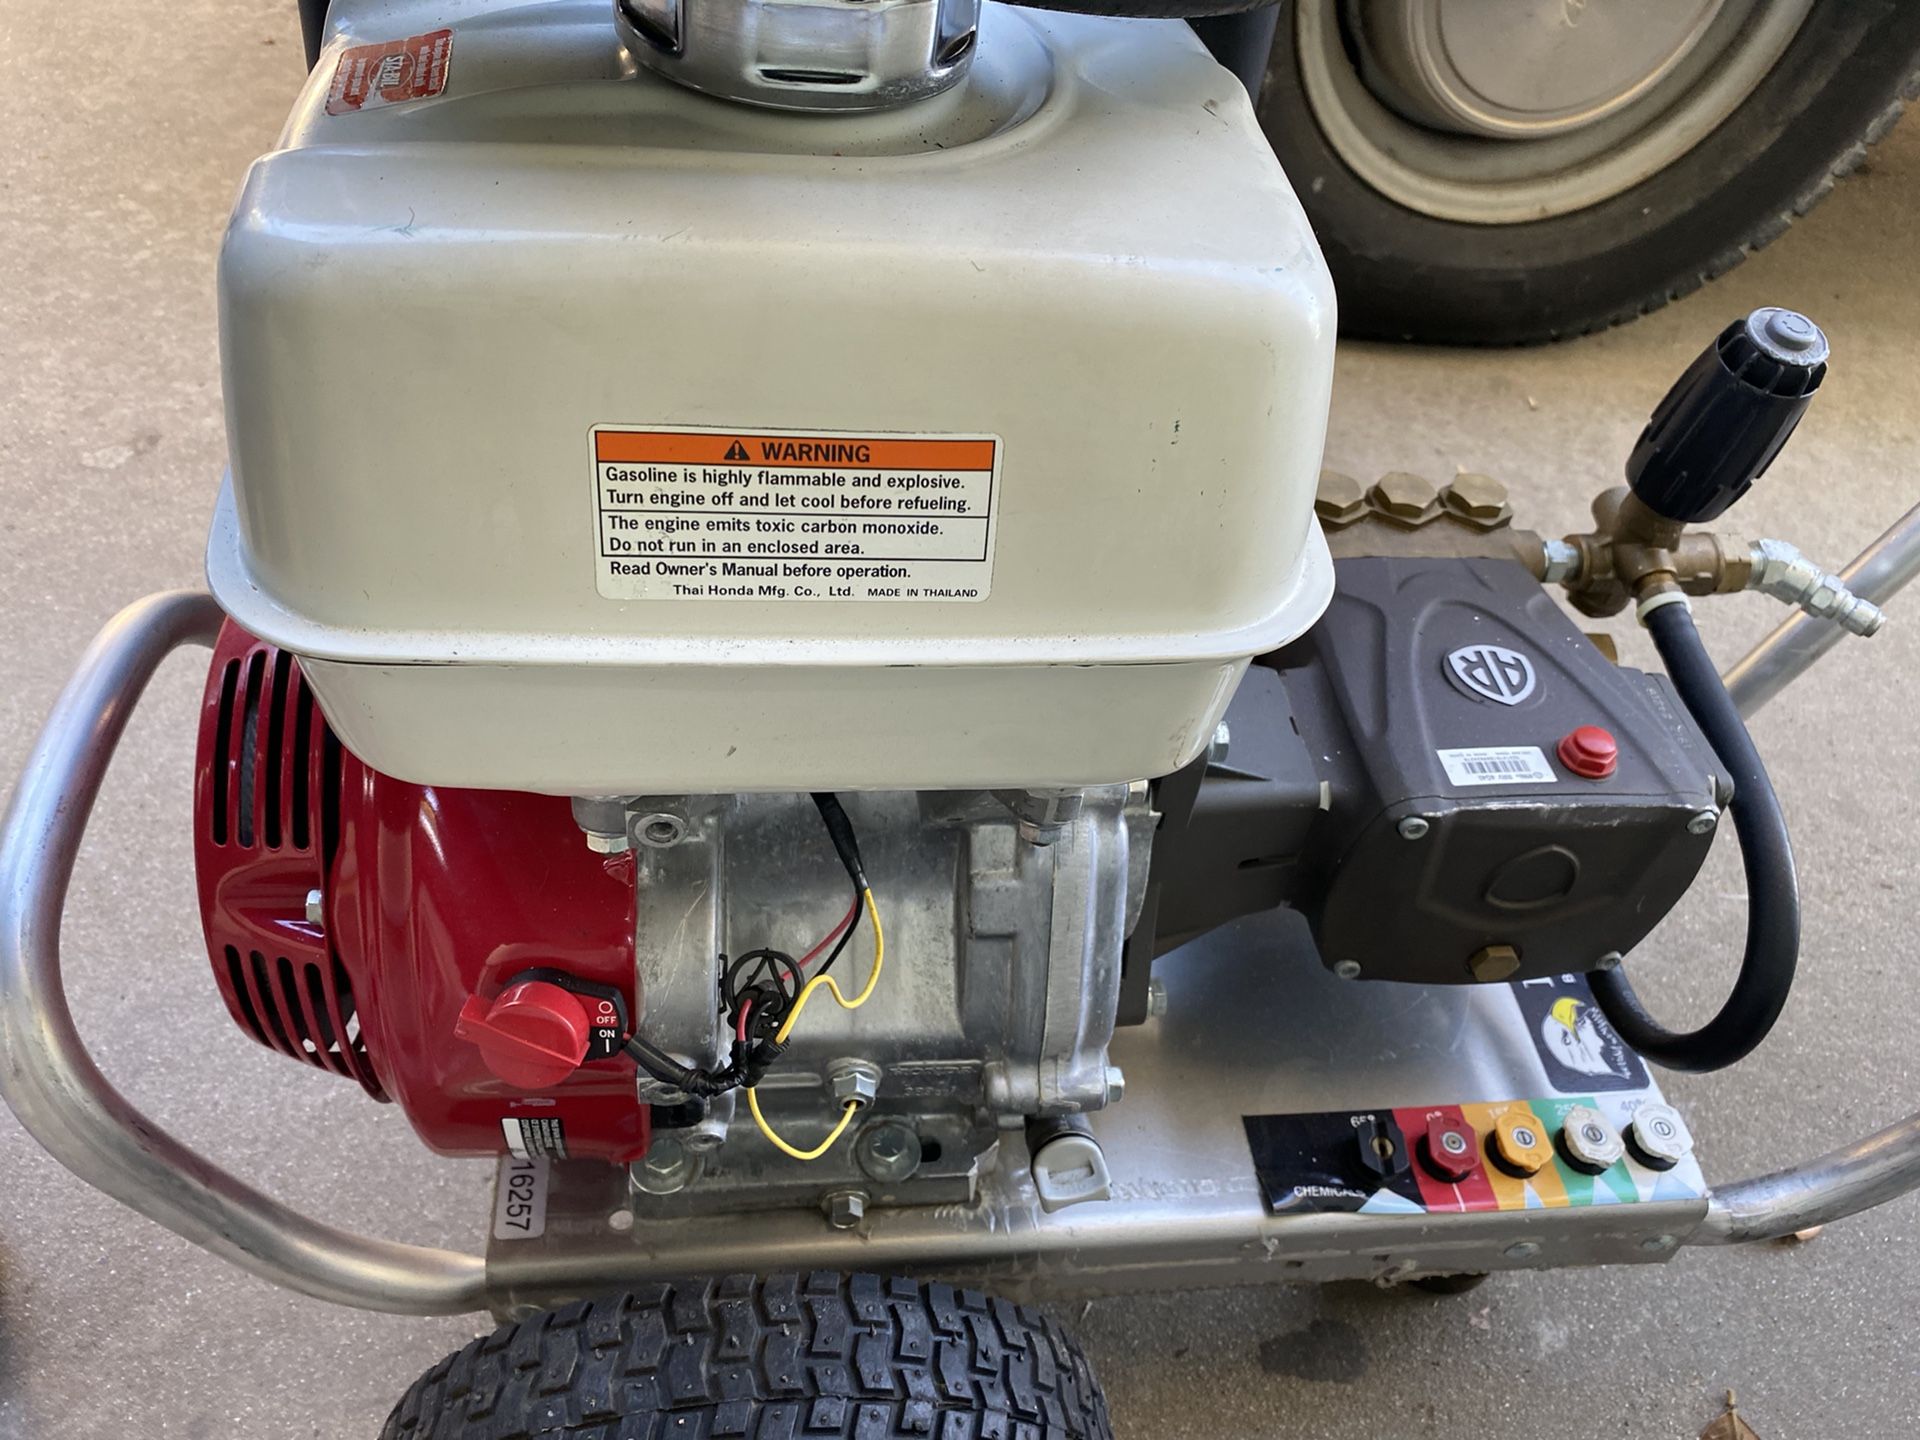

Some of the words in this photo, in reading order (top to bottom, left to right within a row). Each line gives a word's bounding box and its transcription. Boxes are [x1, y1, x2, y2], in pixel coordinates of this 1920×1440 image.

[761, 441, 871, 463] WARNING
[605, 466, 678, 483] Gasoline
[683, 468, 697, 483] is
[702, 468, 752, 488] highly
[757, 470, 846, 487] flammable
[851, 473, 882, 488] and
[886, 474, 965, 491] explosive.
[606, 489, 644, 504] Turn
[649, 490, 705, 508] engine
[711, 492, 734, 506] off
[739, 493, 770, 507] and
[775, 493, 796, 508] let
[800, 494, 835, 508] cool
[840, 494, 893, 509] before
[897, 496, 972, 513] refueling.
[608, 515, 639, 530] The
[644, 516, 700, 533] engine
[706, 517, 751, 532] emits
[755, 518, 796, 533] toxic
[800, 519, 857, 534] carbon
[862, 521, 944, 535] monoxide.
[609, 537, 632, 552] Do
[637, 538, 664, 552] not
[669, 540, 696, 552] run
[702, 538, 716, 553] in
[722, 540, 742, 553] an
[747, 540, 819, 554] enclosed
[824, 543, 865, 555] area.
[610, 561, 651, 576] Read
[655, 561, 718, 576] Owner's
[722, 562, 778, 577] Manual
[783, 563, 832, 578] before
[836, 564, 911, 580] operation.
[673, 584, 704, 596] Thai
[708, 585, 754, 597] Honda
[758, 585, 790, 598] Mfg.
[793, 586, 821, 598] Co.,
[828, 586, 855, 598] Ltd.
[867, 588, 901, 598] MADE
[906, 588, 919, 598] IN
[922, 588, 979, 598] THAILAND
[596, 1016, 617, 1024] OFF
[598, 1029, 616, 1039] ON
[505, 1161, 536, 1232] 16257
